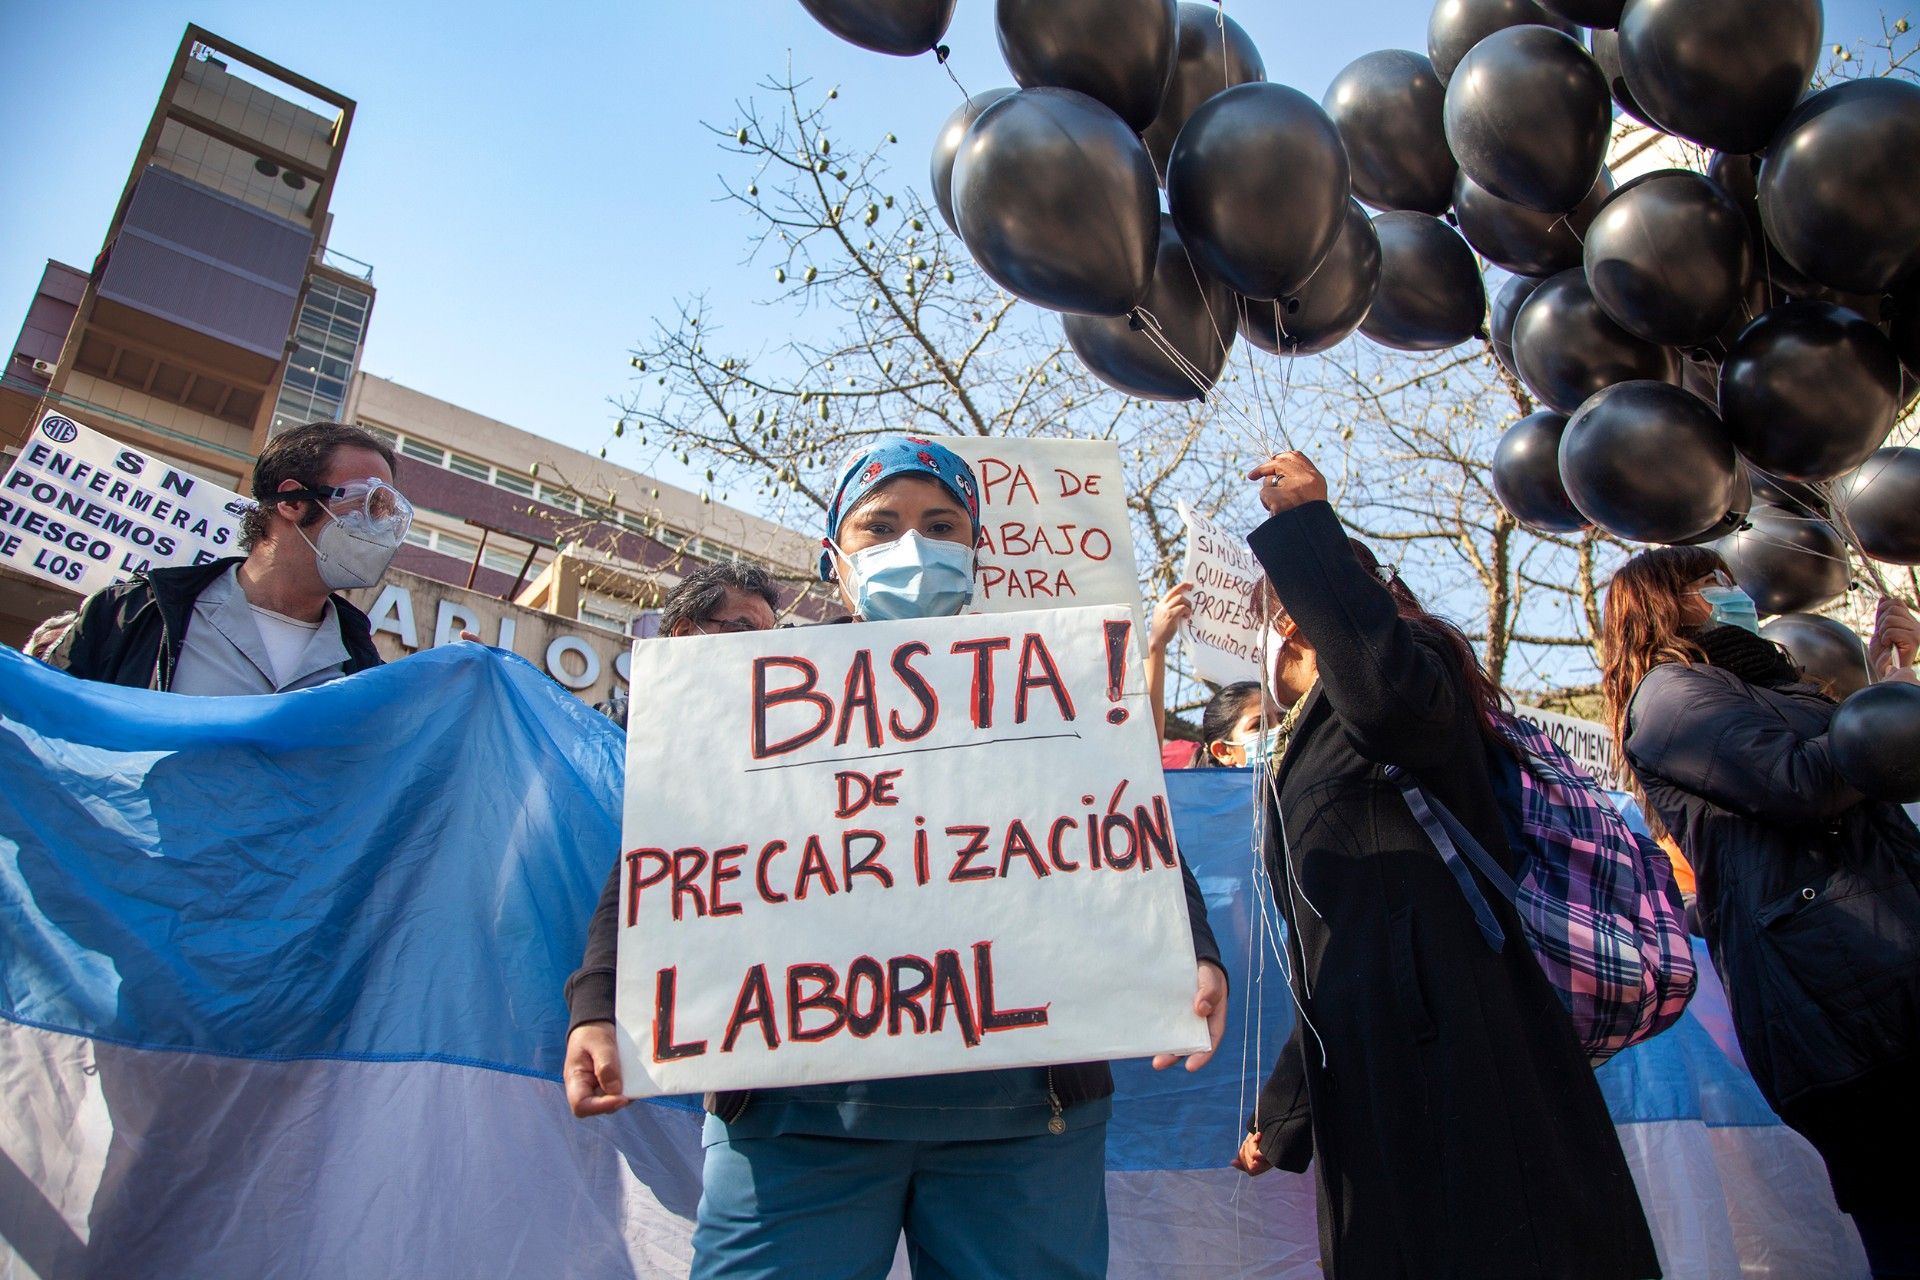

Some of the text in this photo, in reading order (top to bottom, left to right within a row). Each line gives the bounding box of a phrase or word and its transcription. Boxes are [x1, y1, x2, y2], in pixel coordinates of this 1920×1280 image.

[46, 418, 74, 441] ATE
[28, 444, 230, 545] ENFERMERAS
[978, 457, 1101, 506] PA DE
[0, 497, 112, 561] RIESGO
[7, 470, 176, 556] PONEMOS
[33, 548, 83, 581] LOS
[979, 522, 1111, 561] ABAJO
[976, 565, 1076, 599] PARA
[1196, 561, 1252, 597] QUIERO
[834, 769, 904, 819] DE
[652, 940, 1052, 1063] LABORAL
